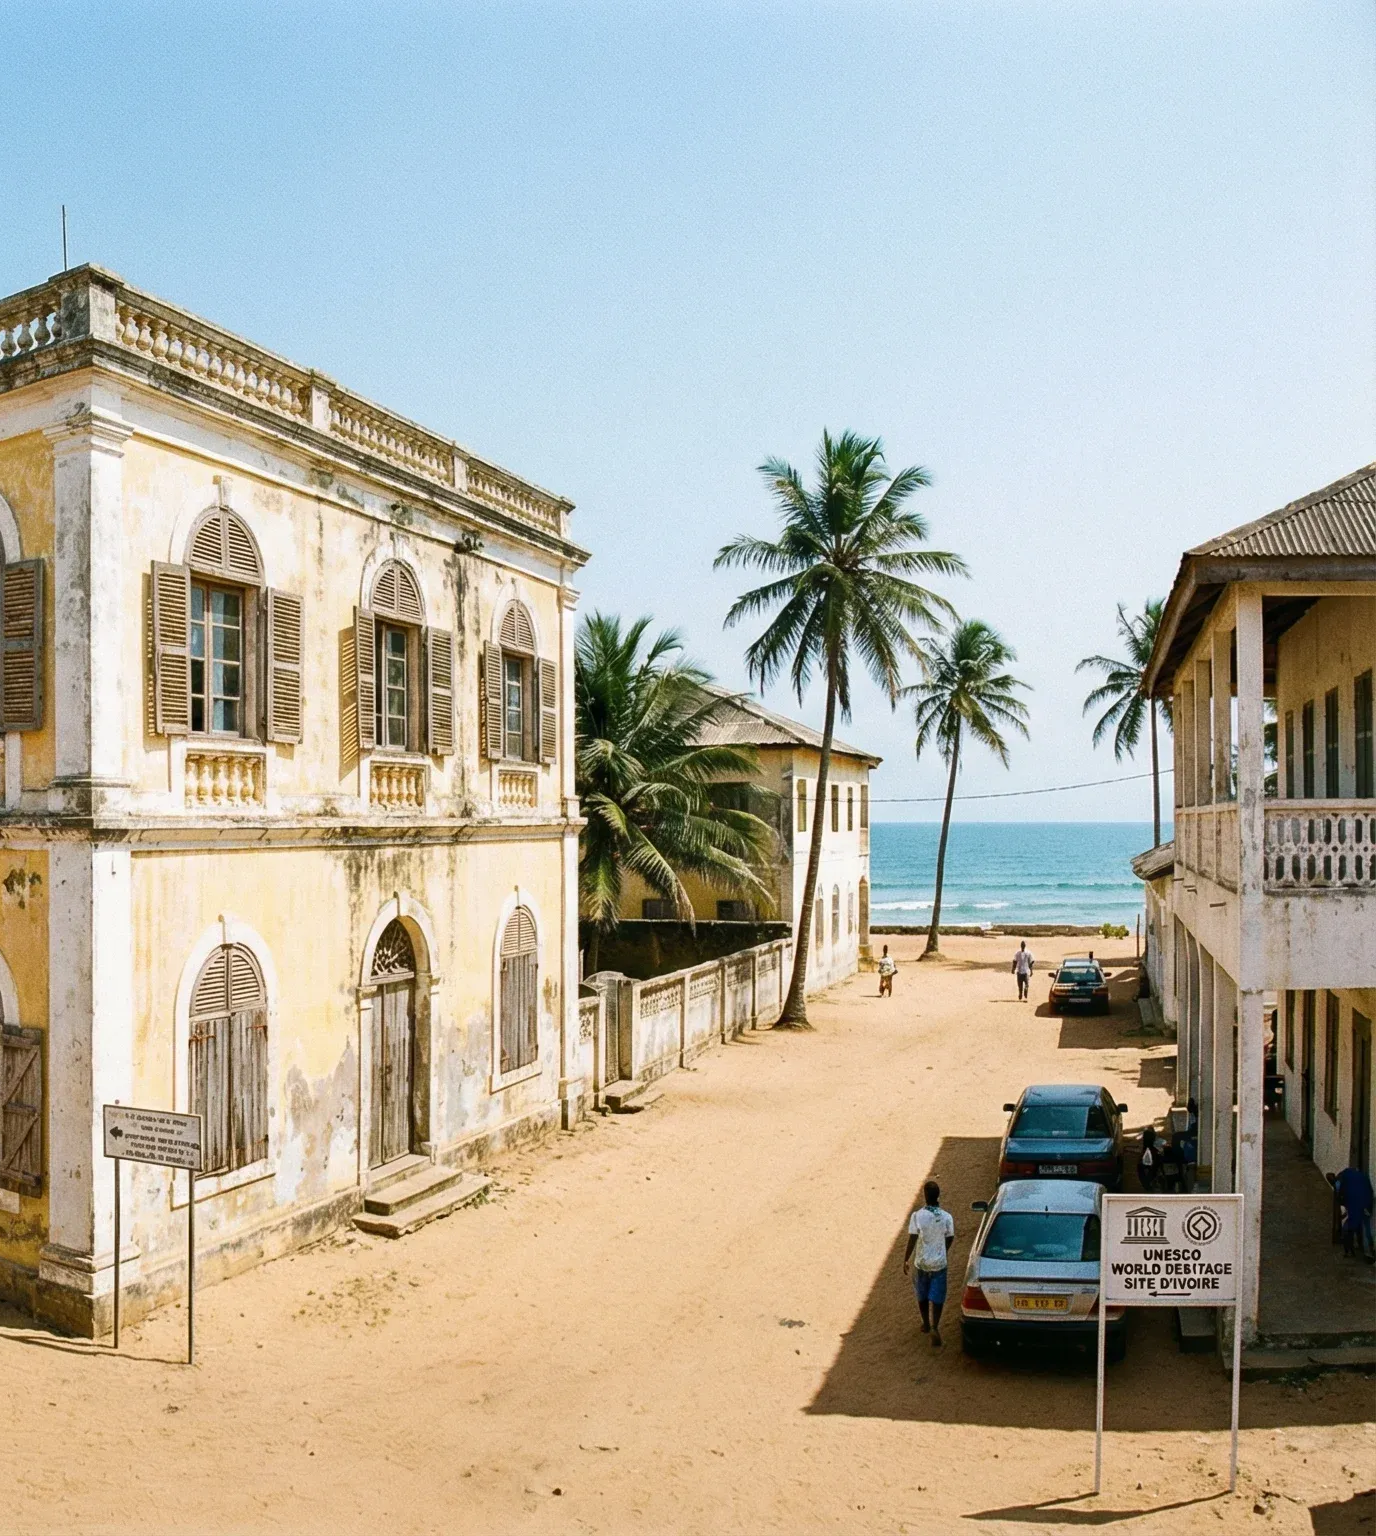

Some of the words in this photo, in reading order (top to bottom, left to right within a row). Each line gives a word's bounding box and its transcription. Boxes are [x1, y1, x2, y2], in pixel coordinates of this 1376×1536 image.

[1143, 1248, 1201, 1262] UNESCO
[1111, 1263, 1161, 1275] WORLD
[1124, 1277, 1155, 1290] SITE
[1160, 1277, 1219, 1290] D'IVOIRE
